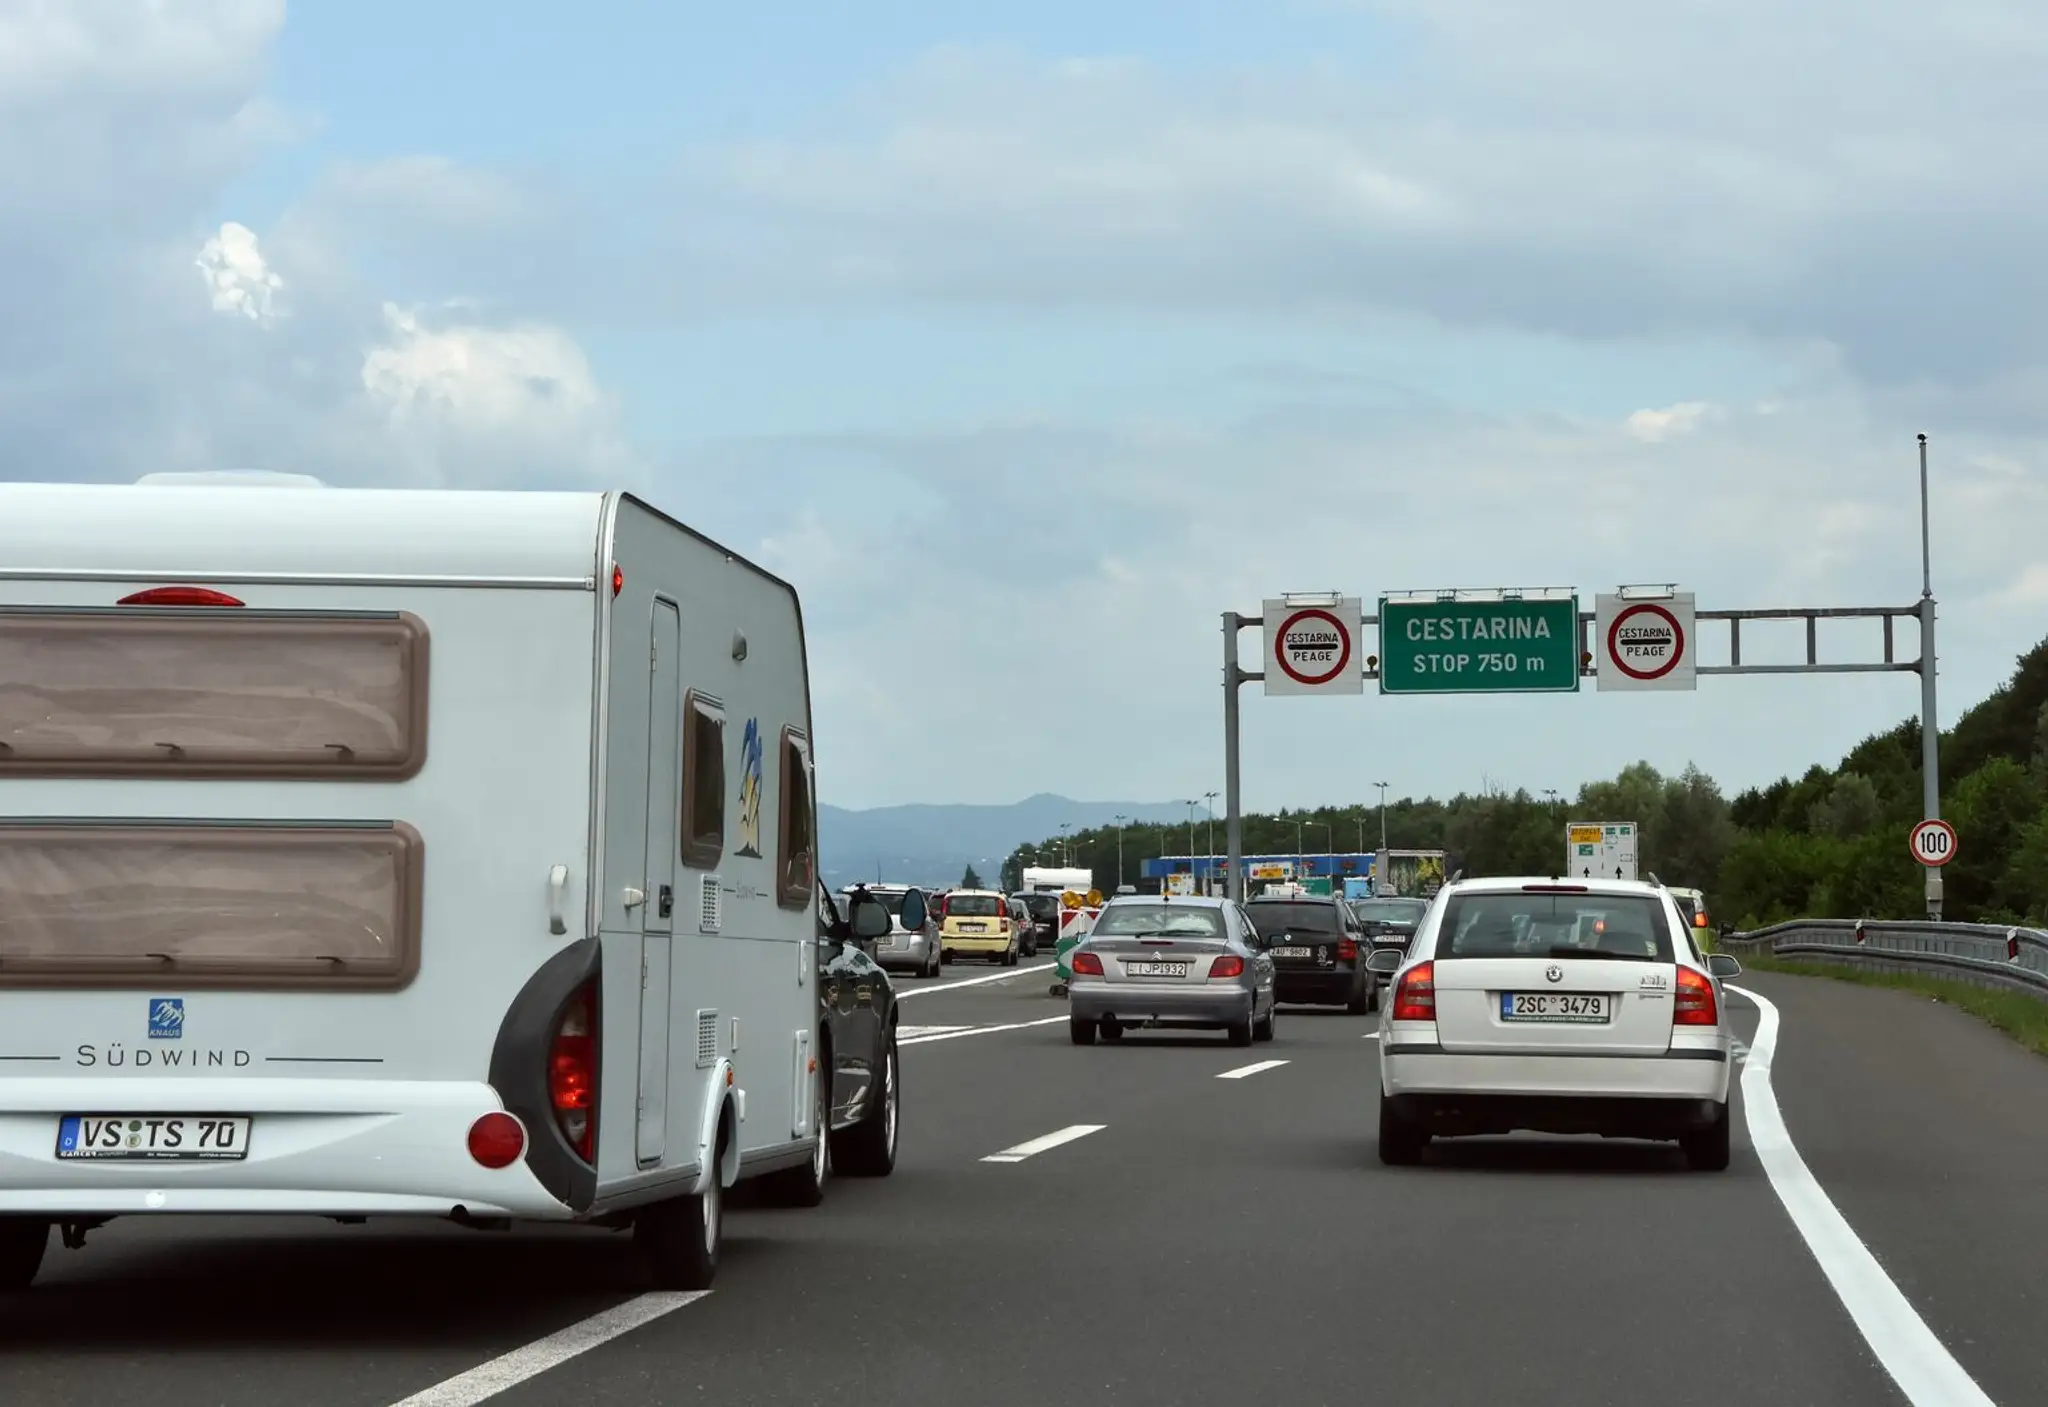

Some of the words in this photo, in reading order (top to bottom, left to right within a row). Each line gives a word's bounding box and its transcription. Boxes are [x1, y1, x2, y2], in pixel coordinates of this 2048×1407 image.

[1286, 633, 1339, 643] CESTARINA
[1406, 616, 1552, 641] CESTARINA
[1619, 627, 1672, 639] CESTARINA
[1293, 651, 1332, 661] PEAGE
[1626, 646, 1665, 657] PEAGE
[1413, 654, 1470, 673] STOP
[1478, 653, 1517, 672] 750
[1526, 656, 1545, 672] m
[1921, 832, 1947, 853] 100
[1516, 996, 1547, 1013] 2SC
[1560, 997, 1601, 1015] 3479
[149, 1029, 181, 1037] KNAUS
[77, 1043, 250, 1067] SÜDWIND
[83, 1120, 123, 1147] VS
[146, 1121, 184, 1148] TS
[198, 1122, 235, 1148] 70
